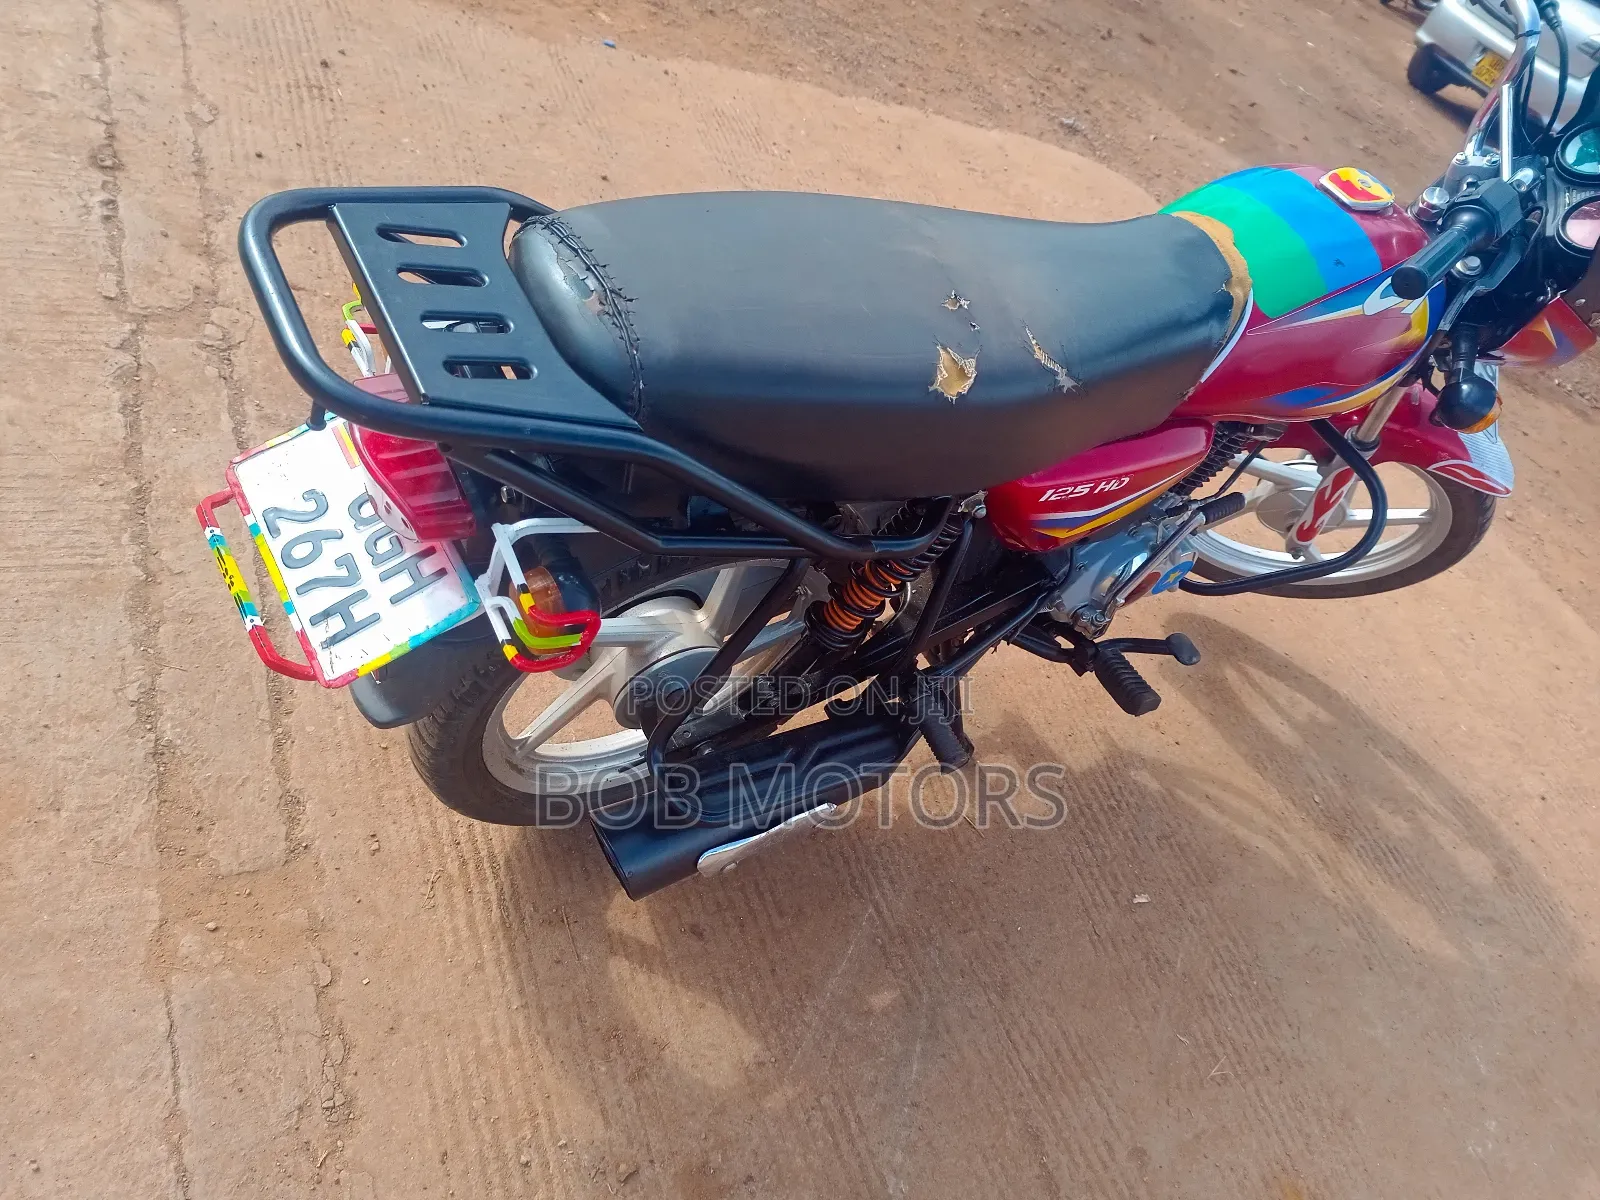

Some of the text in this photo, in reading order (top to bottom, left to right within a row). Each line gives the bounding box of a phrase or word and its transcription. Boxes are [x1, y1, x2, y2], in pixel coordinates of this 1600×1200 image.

[1037, 477, 1131, 502] 125 HD
[262, 488, 381, 650] 267H
